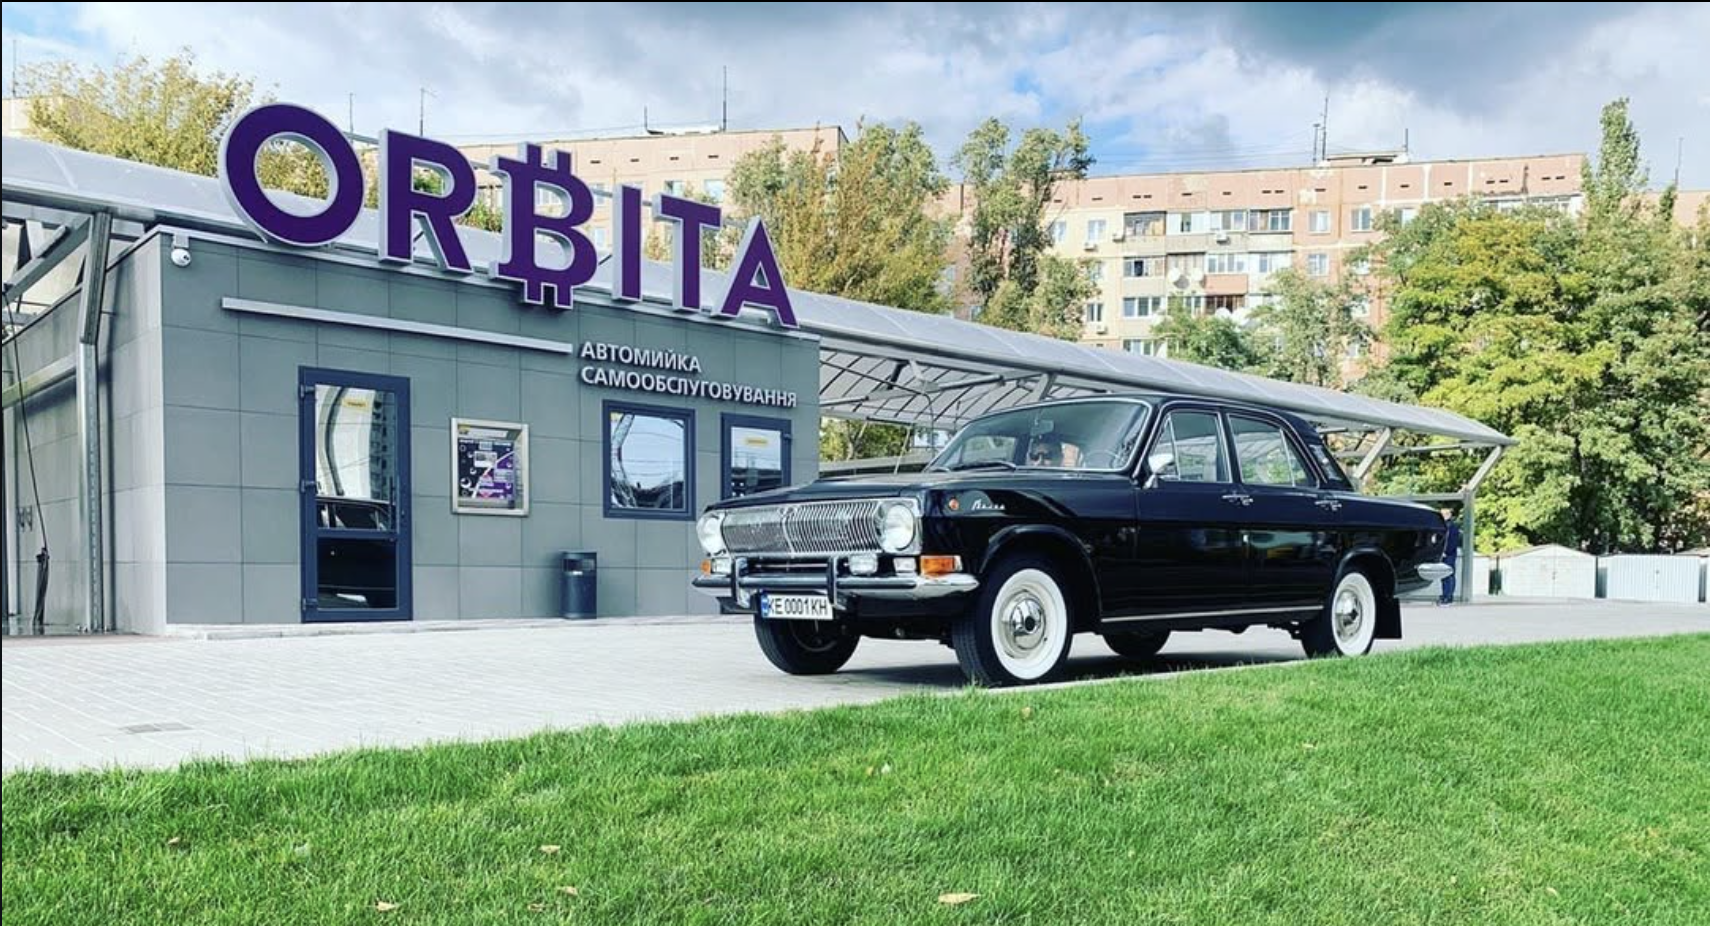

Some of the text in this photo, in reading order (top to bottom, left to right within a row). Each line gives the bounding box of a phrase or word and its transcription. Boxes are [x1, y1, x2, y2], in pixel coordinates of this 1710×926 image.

[219, 102, 799, 328] ORBITA
[580, 341, 702, 373] АВТОМИЙКА
[580, 366, 798, 408] САМООБСЛУГОВУВАННЯ
